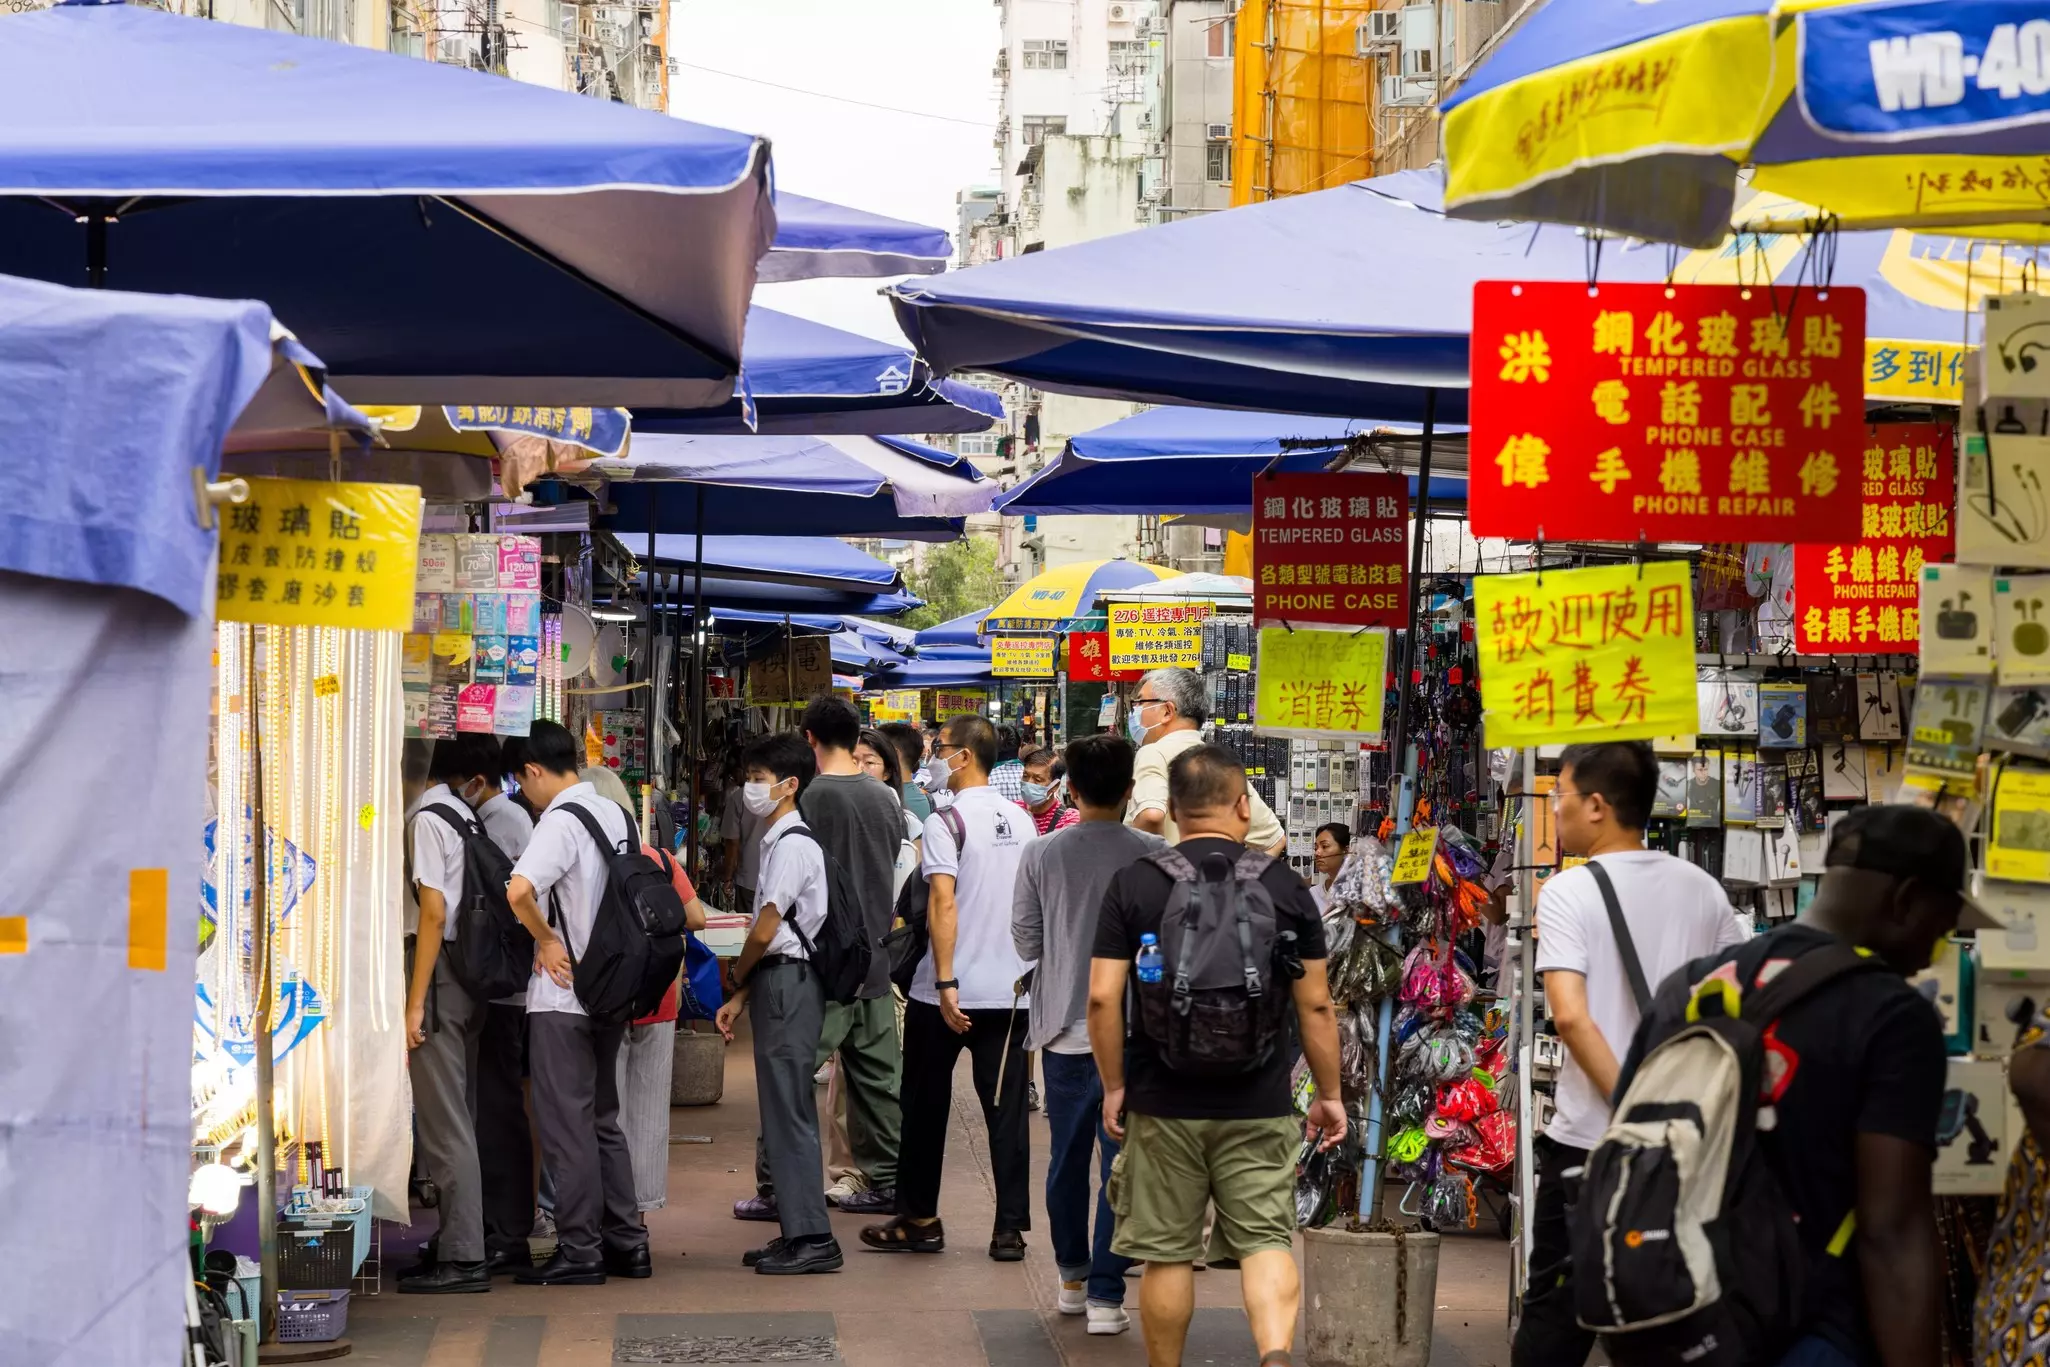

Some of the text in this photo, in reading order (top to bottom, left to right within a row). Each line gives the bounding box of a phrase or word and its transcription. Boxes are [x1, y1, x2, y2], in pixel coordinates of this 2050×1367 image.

[1619, 357, 1812, 377] TEMPERED GLASS
[1591, 379, 1842, 430] 電話配件
[1646, 427, 1785, 447] PHONE CASE
[1495, 433, 1551, 489] 偉
[1589, 447, 1842, 497] 手機維修
[1888, 482, 1925, 496] GLASS
[1633, 495, 1796, 516] PHONE REPAIR
[1259, 528, 1403, 544] TEMPERED GLASS
[1824, 545, 1926, 584] 手機維修
[1031, 590, 1066, 600] WD-40
[1833, 584, 1916, 599] PHONE REPAIR
[1266, 594, 1399, 610] PHONE CASE
[1114, 611, 1140, 622] 276
